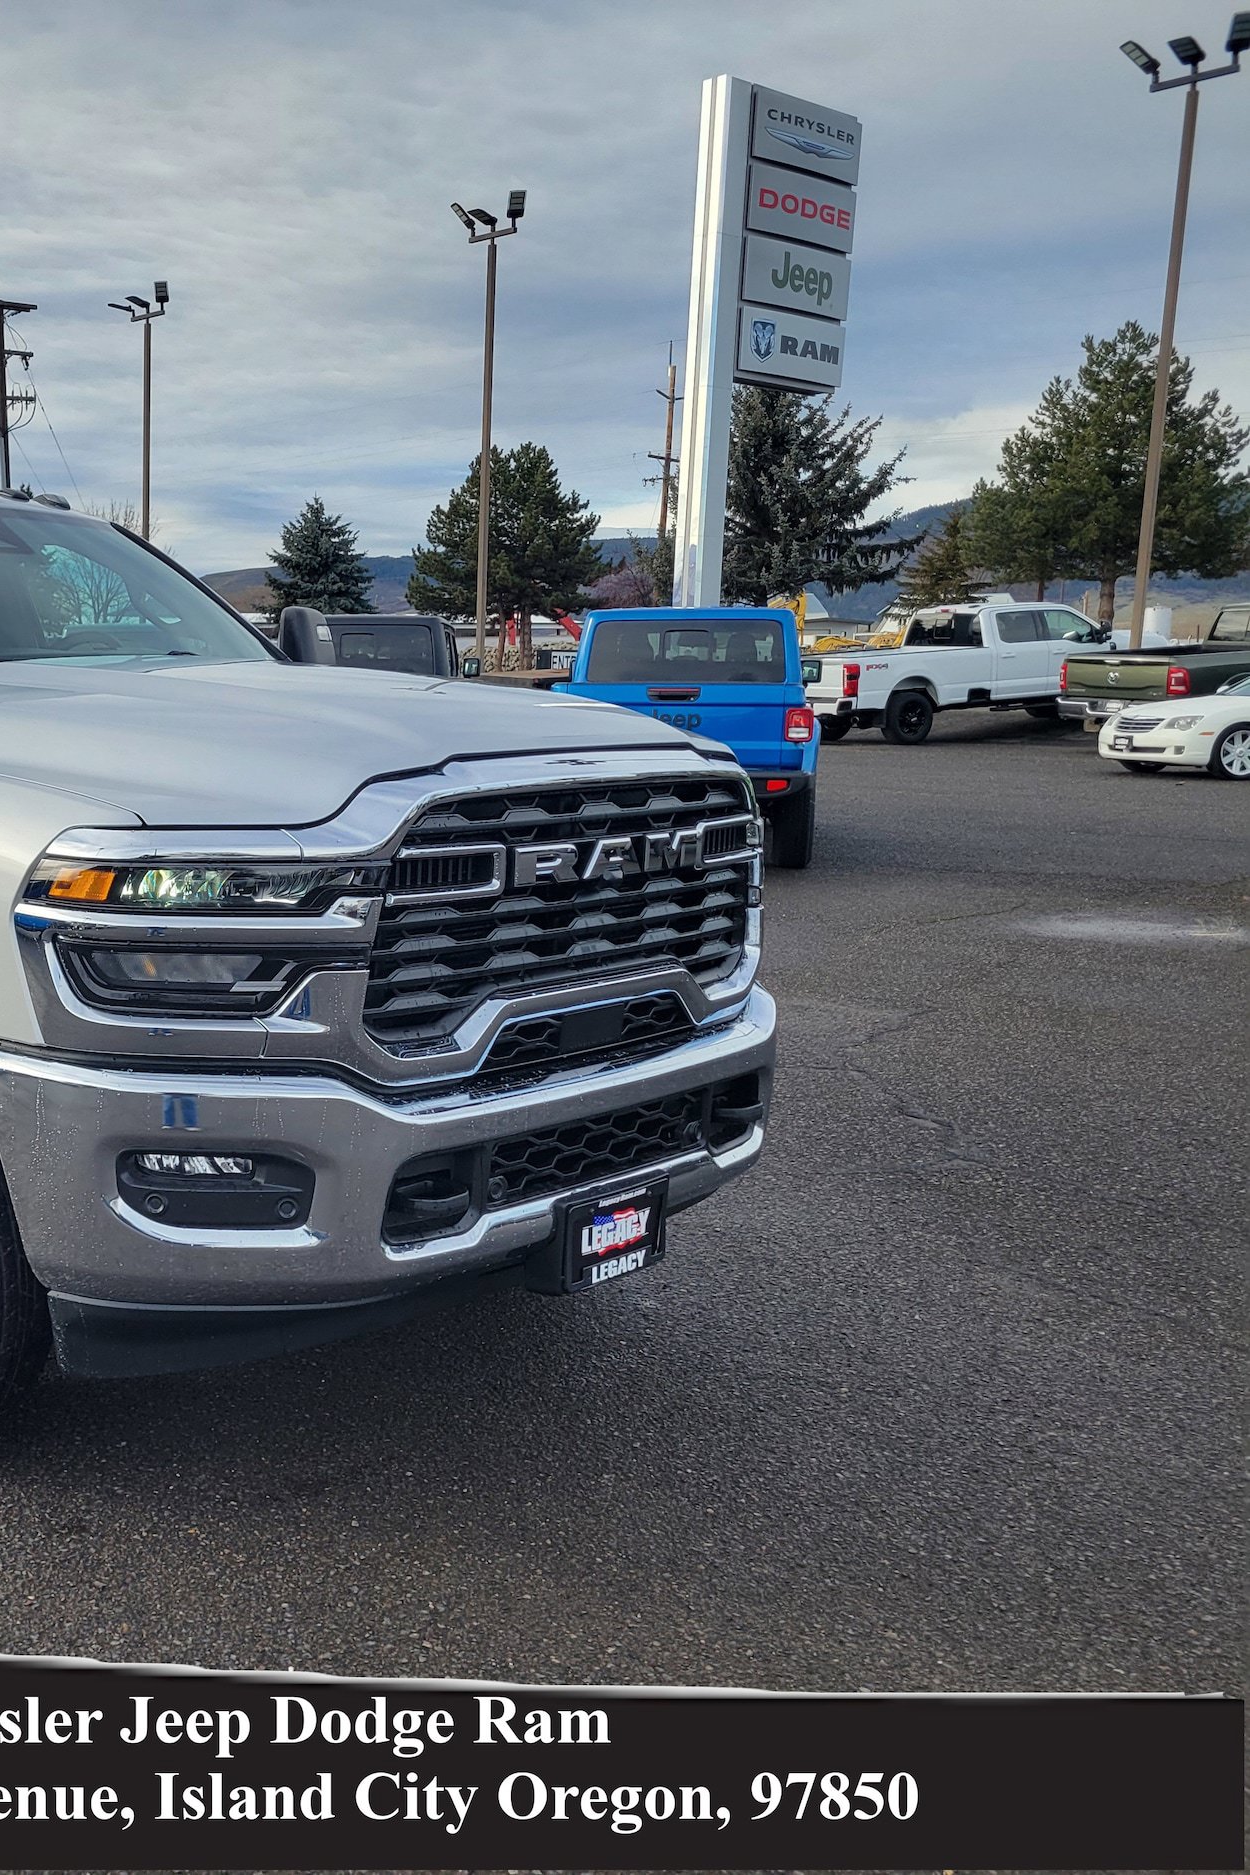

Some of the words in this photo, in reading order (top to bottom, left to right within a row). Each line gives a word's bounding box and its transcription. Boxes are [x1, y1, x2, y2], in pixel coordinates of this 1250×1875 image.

[766, 108, 855, 145] CHRYSLER
[758, 188, 851, 230] DODGE
[771, 251, 833, 305] Jeep
[779, 335, 840, 365] RAM
[514, 829, 698, 888] RAM
[581, 1209, 651, 1255] LEGACY
[591, 1250, 646, 1284] LEGACY
